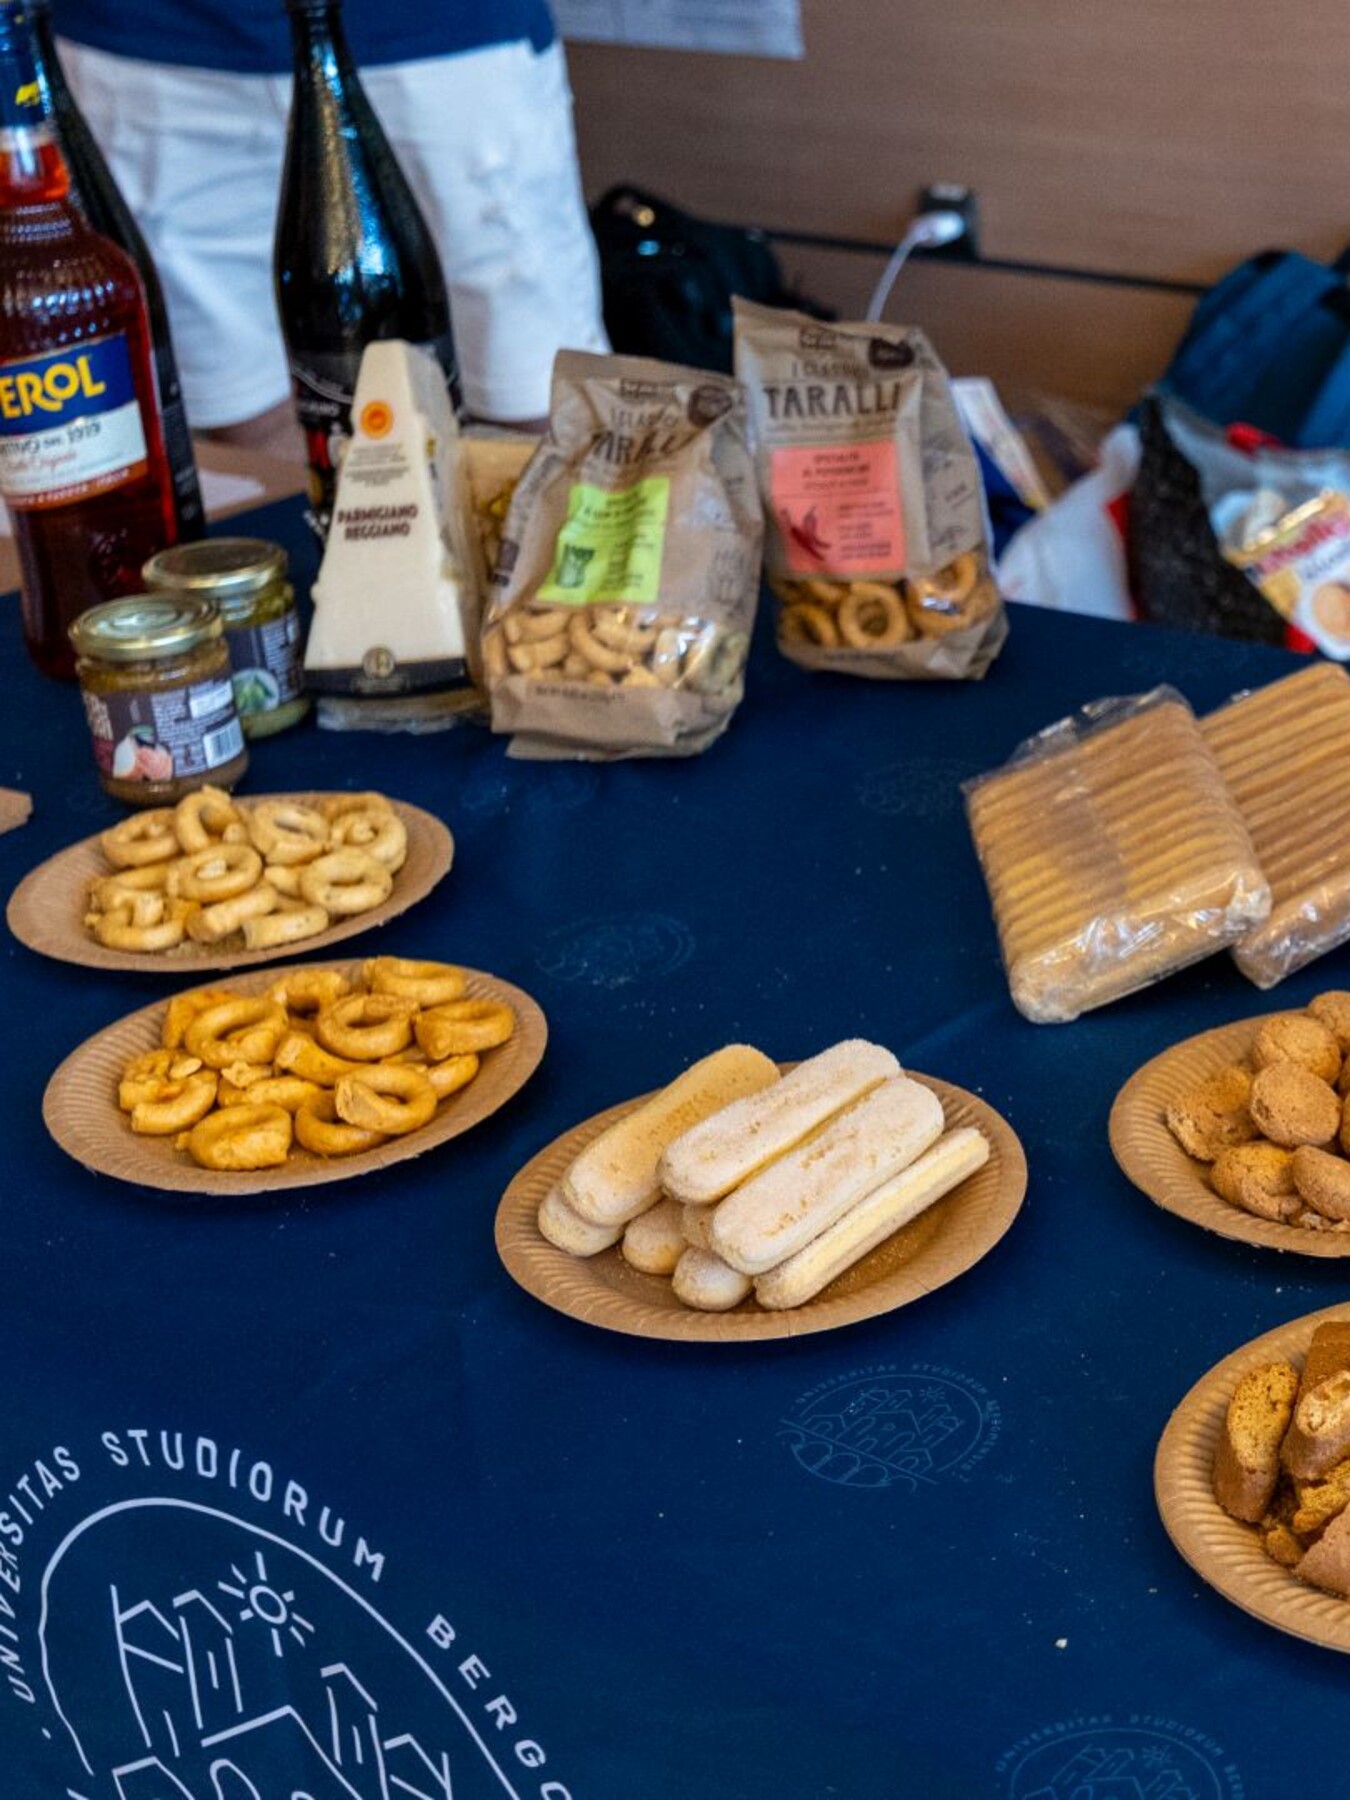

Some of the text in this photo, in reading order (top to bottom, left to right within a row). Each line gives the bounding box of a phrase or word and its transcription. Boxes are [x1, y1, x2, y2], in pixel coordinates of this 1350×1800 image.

[763, 381, 902, 420] TARALLI
[337, 503, 419, 524] PARMIGIANO
[344, 521, 411, 541] REGGIANO
[102, 1428, 386, 1583] STUDIORUM
